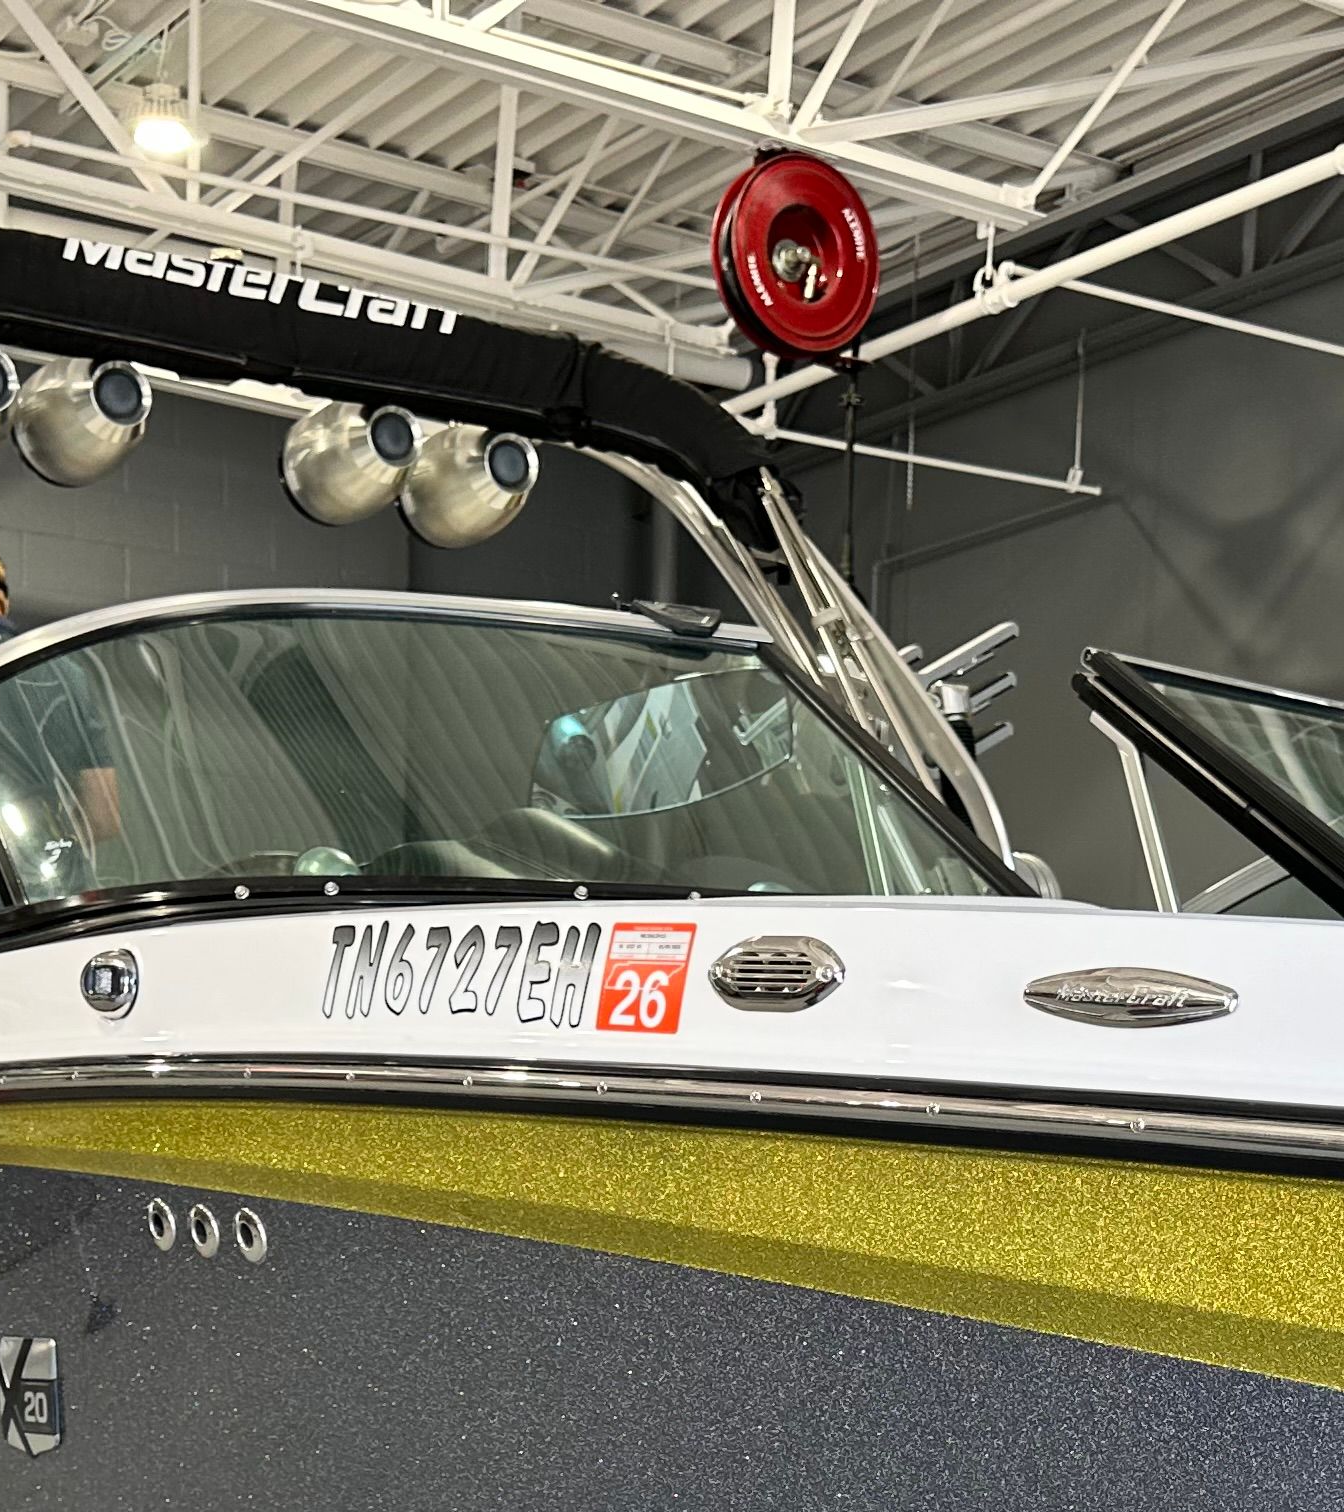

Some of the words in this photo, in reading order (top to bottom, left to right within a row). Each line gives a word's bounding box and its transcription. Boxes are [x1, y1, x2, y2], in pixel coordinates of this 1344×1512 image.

[322, 920, 602, 1029] TN6727EH
[1055, 983, 1190, 1008] MasterCraft
[608, 970, 670, 1029] 26
[23, 1391, 48, 1424] 20
